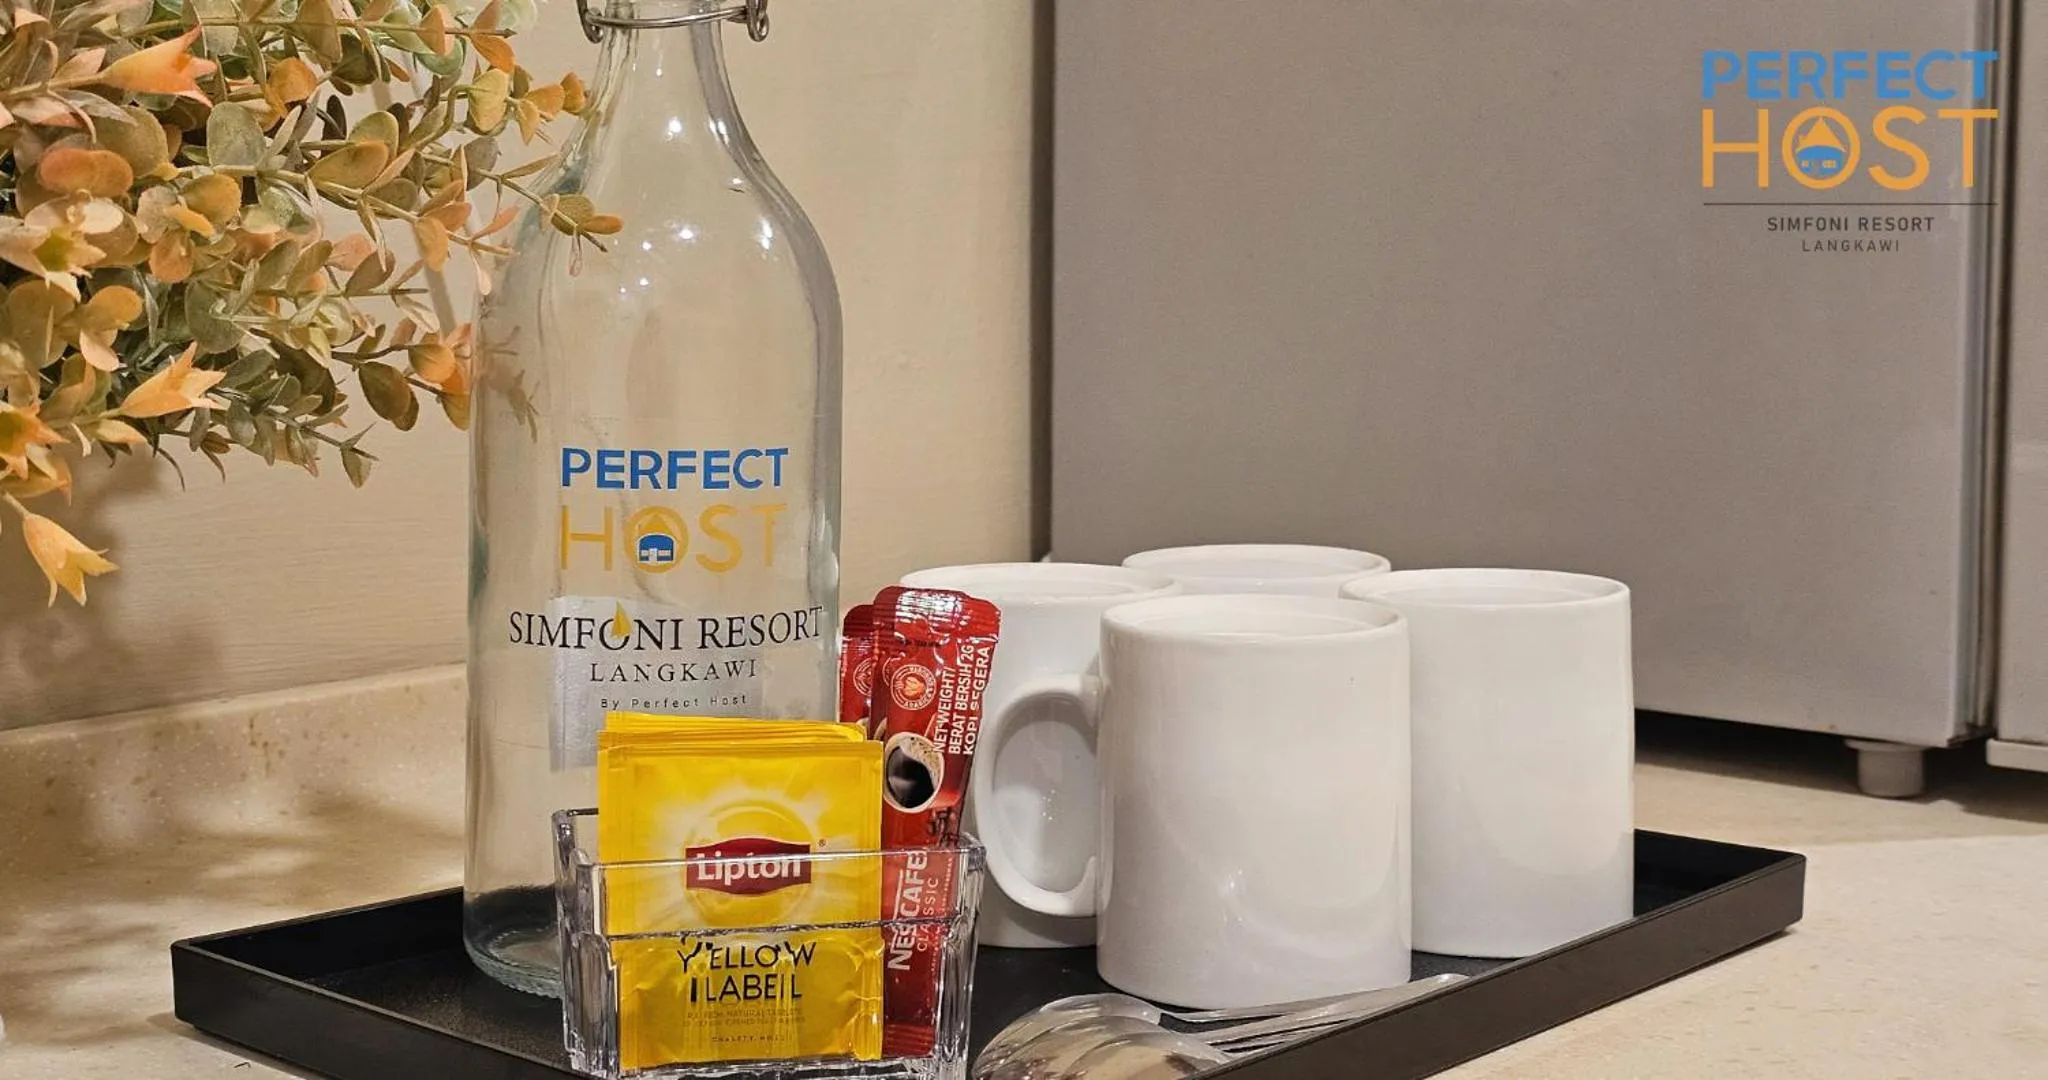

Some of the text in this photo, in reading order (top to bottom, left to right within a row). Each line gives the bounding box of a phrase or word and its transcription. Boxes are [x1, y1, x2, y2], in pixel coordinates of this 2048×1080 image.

[561, 447, 789, 490] PERFECT
[560, 503, 787, 574] HOST
[509, 606, 823, 651] SIMFONI RESORT
[590, 659, 757, 683] LANGKAWI
[601, 694, 747, 710] By Perfect Host
[948, 644, 975, 755] BERAT BERSIH 2G
[963, 717, 979, 755] KOPI
[696, 851, 802, 885] Lipton
[917, 879, 939, 952] CLASSIC
[677, 941, 817, 973] YELLOW
